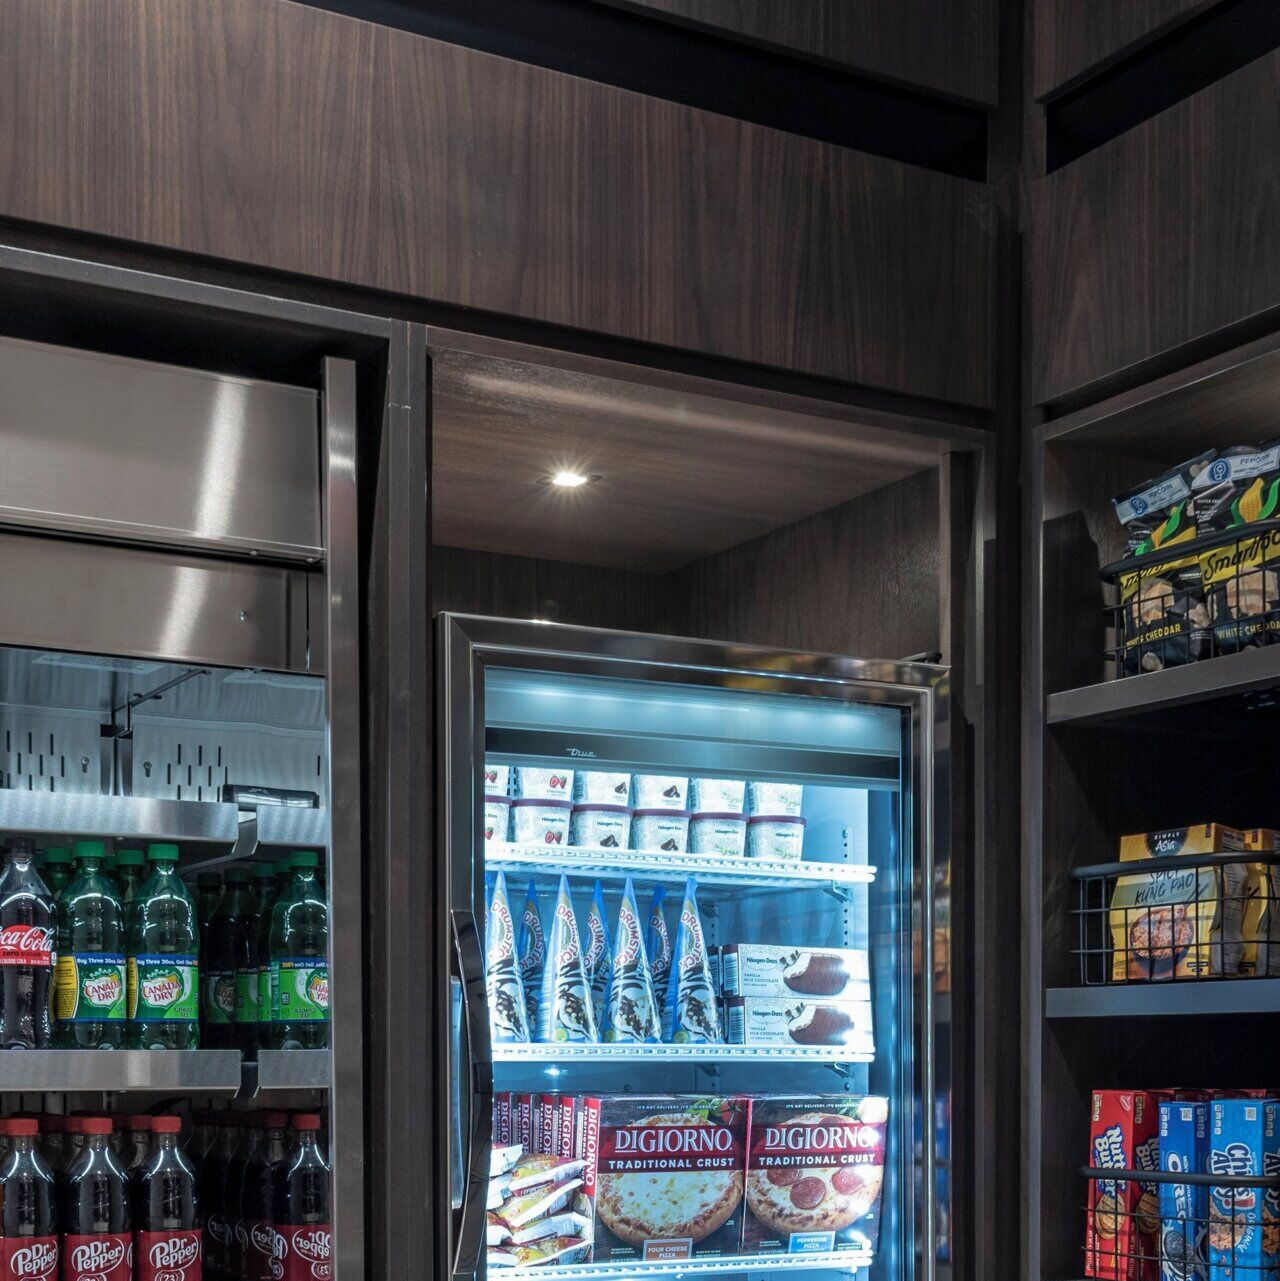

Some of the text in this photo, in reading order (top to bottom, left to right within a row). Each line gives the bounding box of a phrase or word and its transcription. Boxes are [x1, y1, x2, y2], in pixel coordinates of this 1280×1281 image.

[1154, 832, 1180, 840] SIMPLY
[1135, 873, 1194, 905] KUNG PAO
[614, 908, 640, 969] DRUMSTICK
[84, 981, 120, 997] CANADA
[101, 991, 115, 1001] DRY
[142, 981, 181, 998] CANADA
[154, 992, 173, 1002] DRY
[585, 1108, 598, 1186] DIGIORNO
[609, 1157, 735, 1169] TRADITIONAL CRUST
[759, 1153, 875, 1166] TRADITIONAL CRUST
[32, 1244, 49, 1254] Dr
[90, 1241, 109, 1251] Dr
[169, 1238, 187, 1249] Dr
[18, 1248, 57, 1276] Pepper
[76, 1246, 120, 1272] Pepper
[153, 1242, 197, 1268] Pepper
